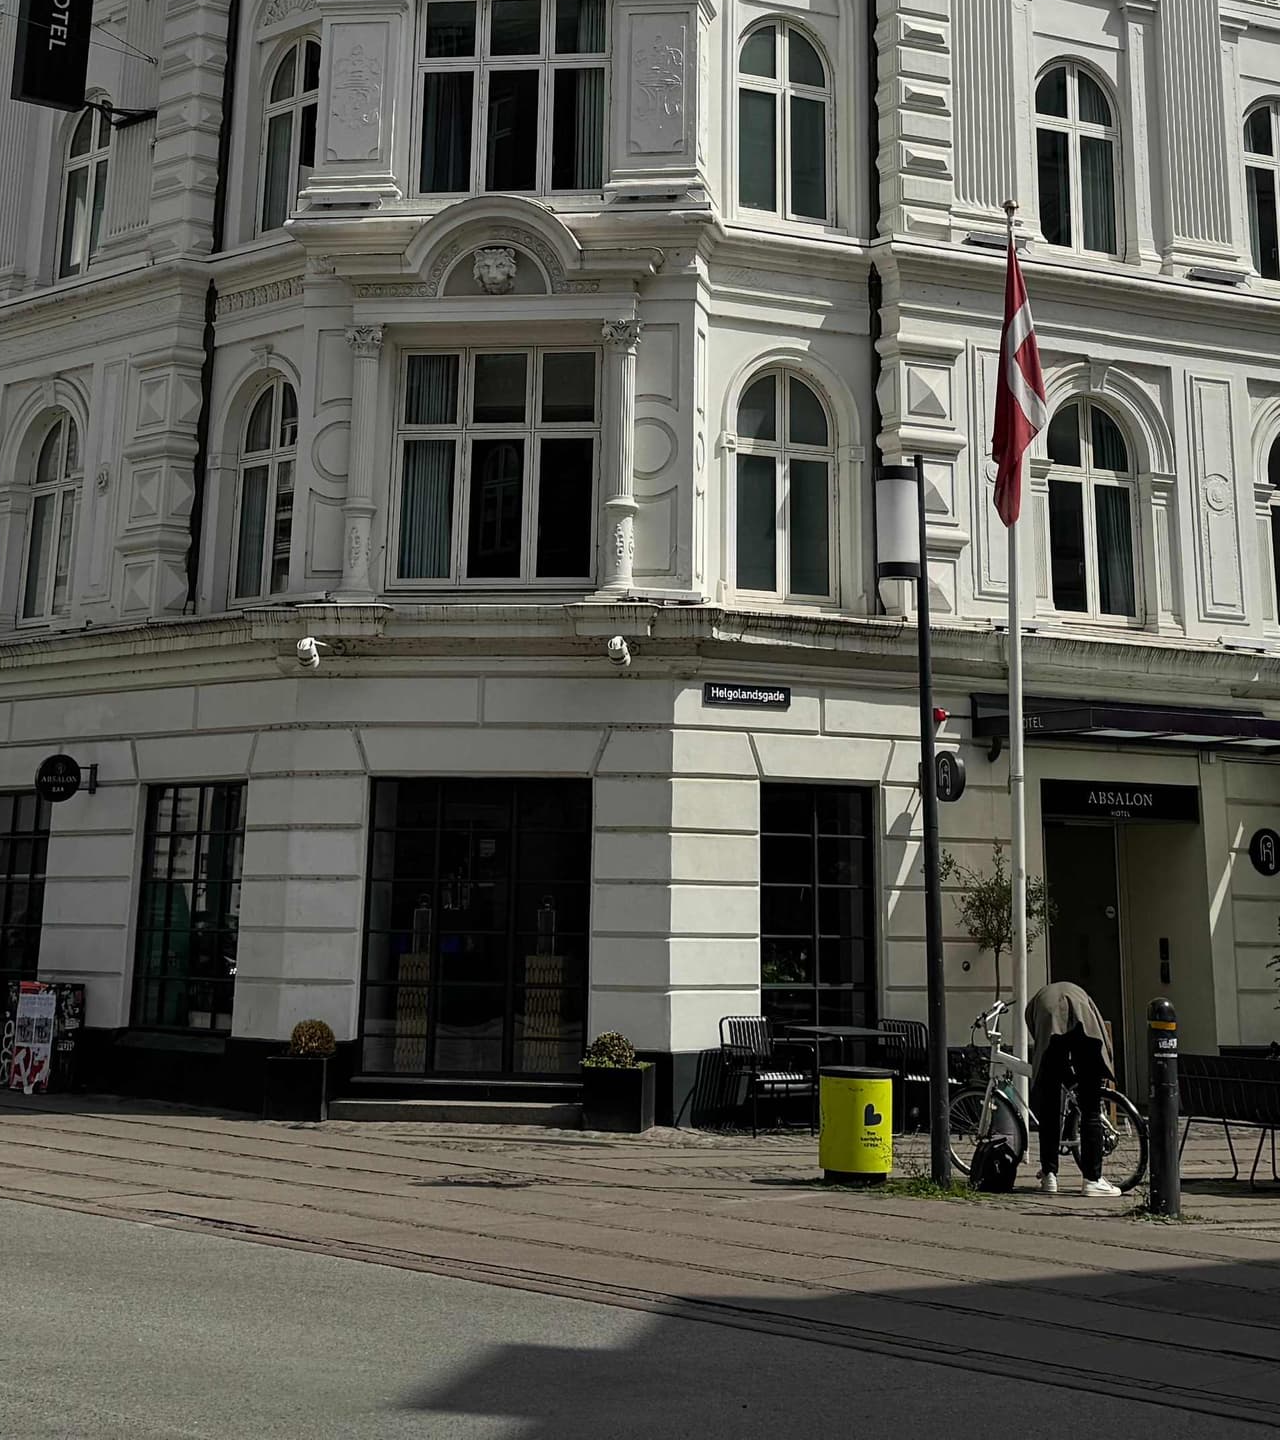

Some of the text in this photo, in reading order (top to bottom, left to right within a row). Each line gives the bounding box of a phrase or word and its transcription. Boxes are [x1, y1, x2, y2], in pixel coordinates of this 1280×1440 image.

[711, 687, 785, 702] Helgolandsgade
[40, 775, 77, 783] ABSALON
[1088, 791, 1154, 807] ABSALON
